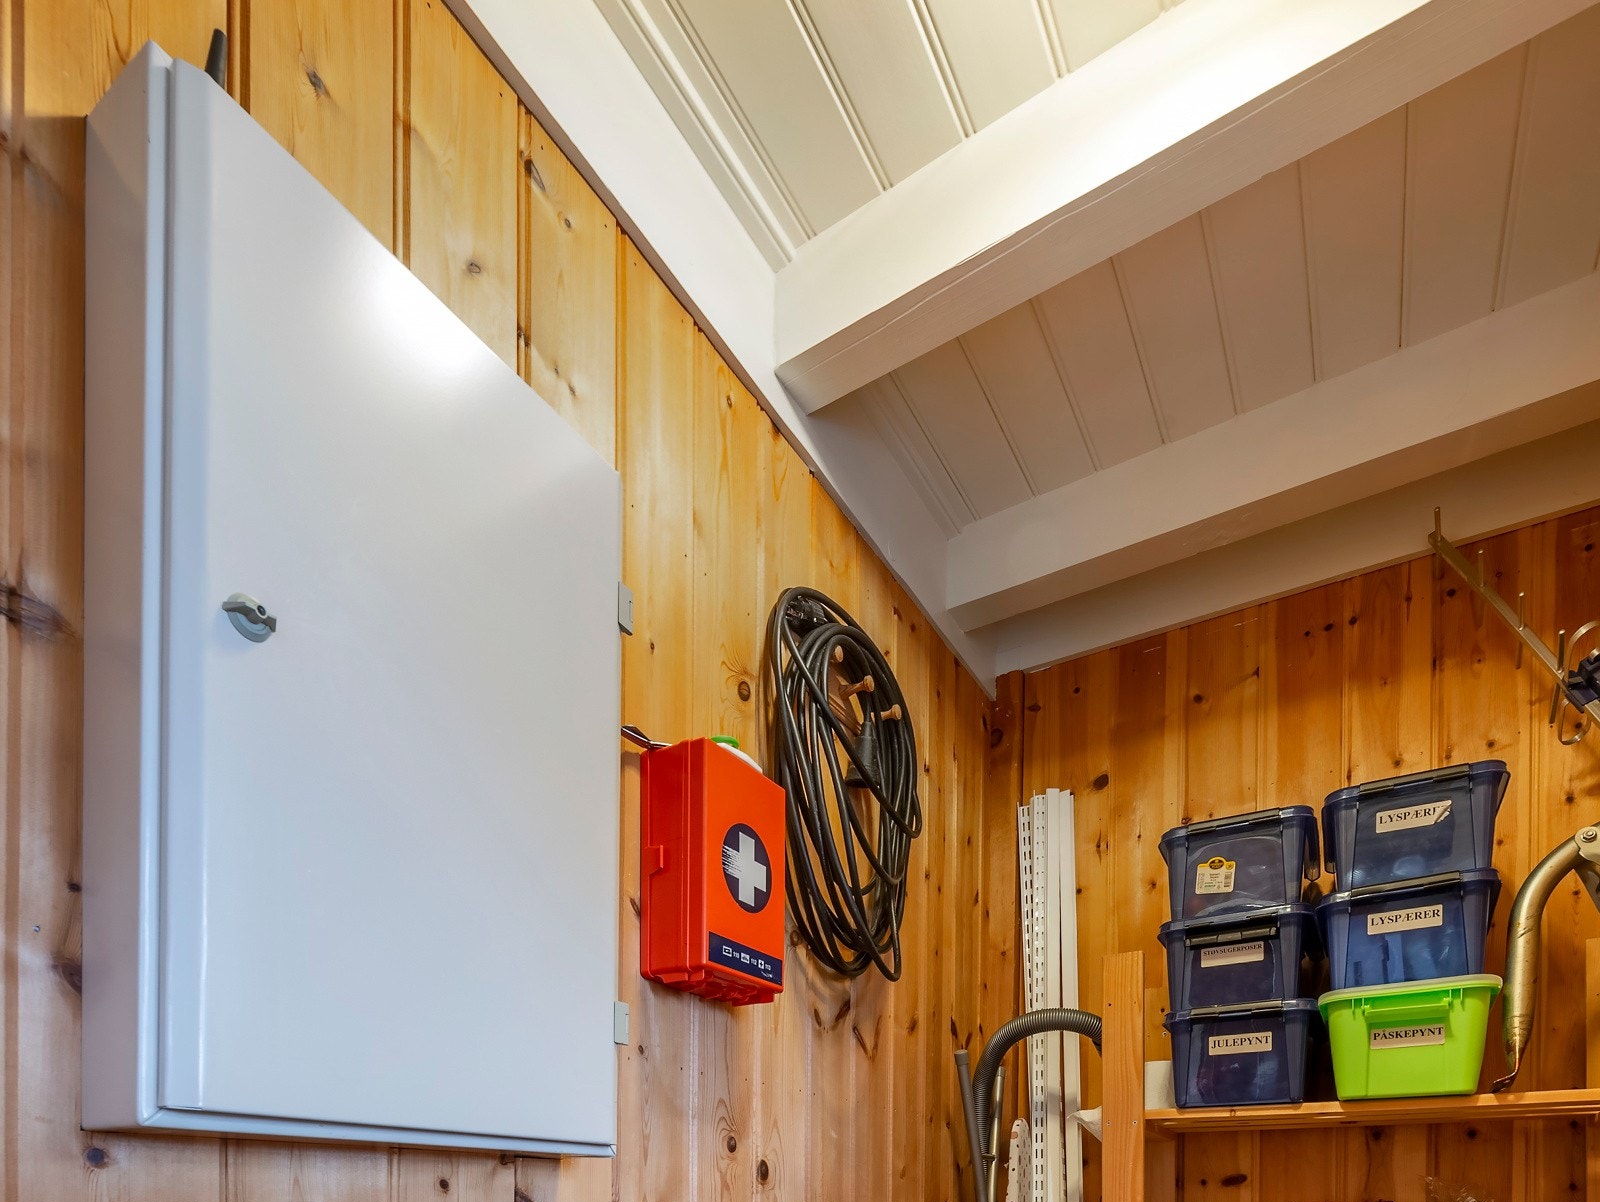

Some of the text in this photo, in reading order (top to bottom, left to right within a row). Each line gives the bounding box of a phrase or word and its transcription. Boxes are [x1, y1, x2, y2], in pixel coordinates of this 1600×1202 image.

[1379, 805, 1446, 824] LYSPÆR
[1370, 908, 1441, 926] LYSPÆRER
[1373, 1026, 1444, 1041] PÅSKEPYNT
[1211, 1035, 1271, 1049] JULEPYNT
